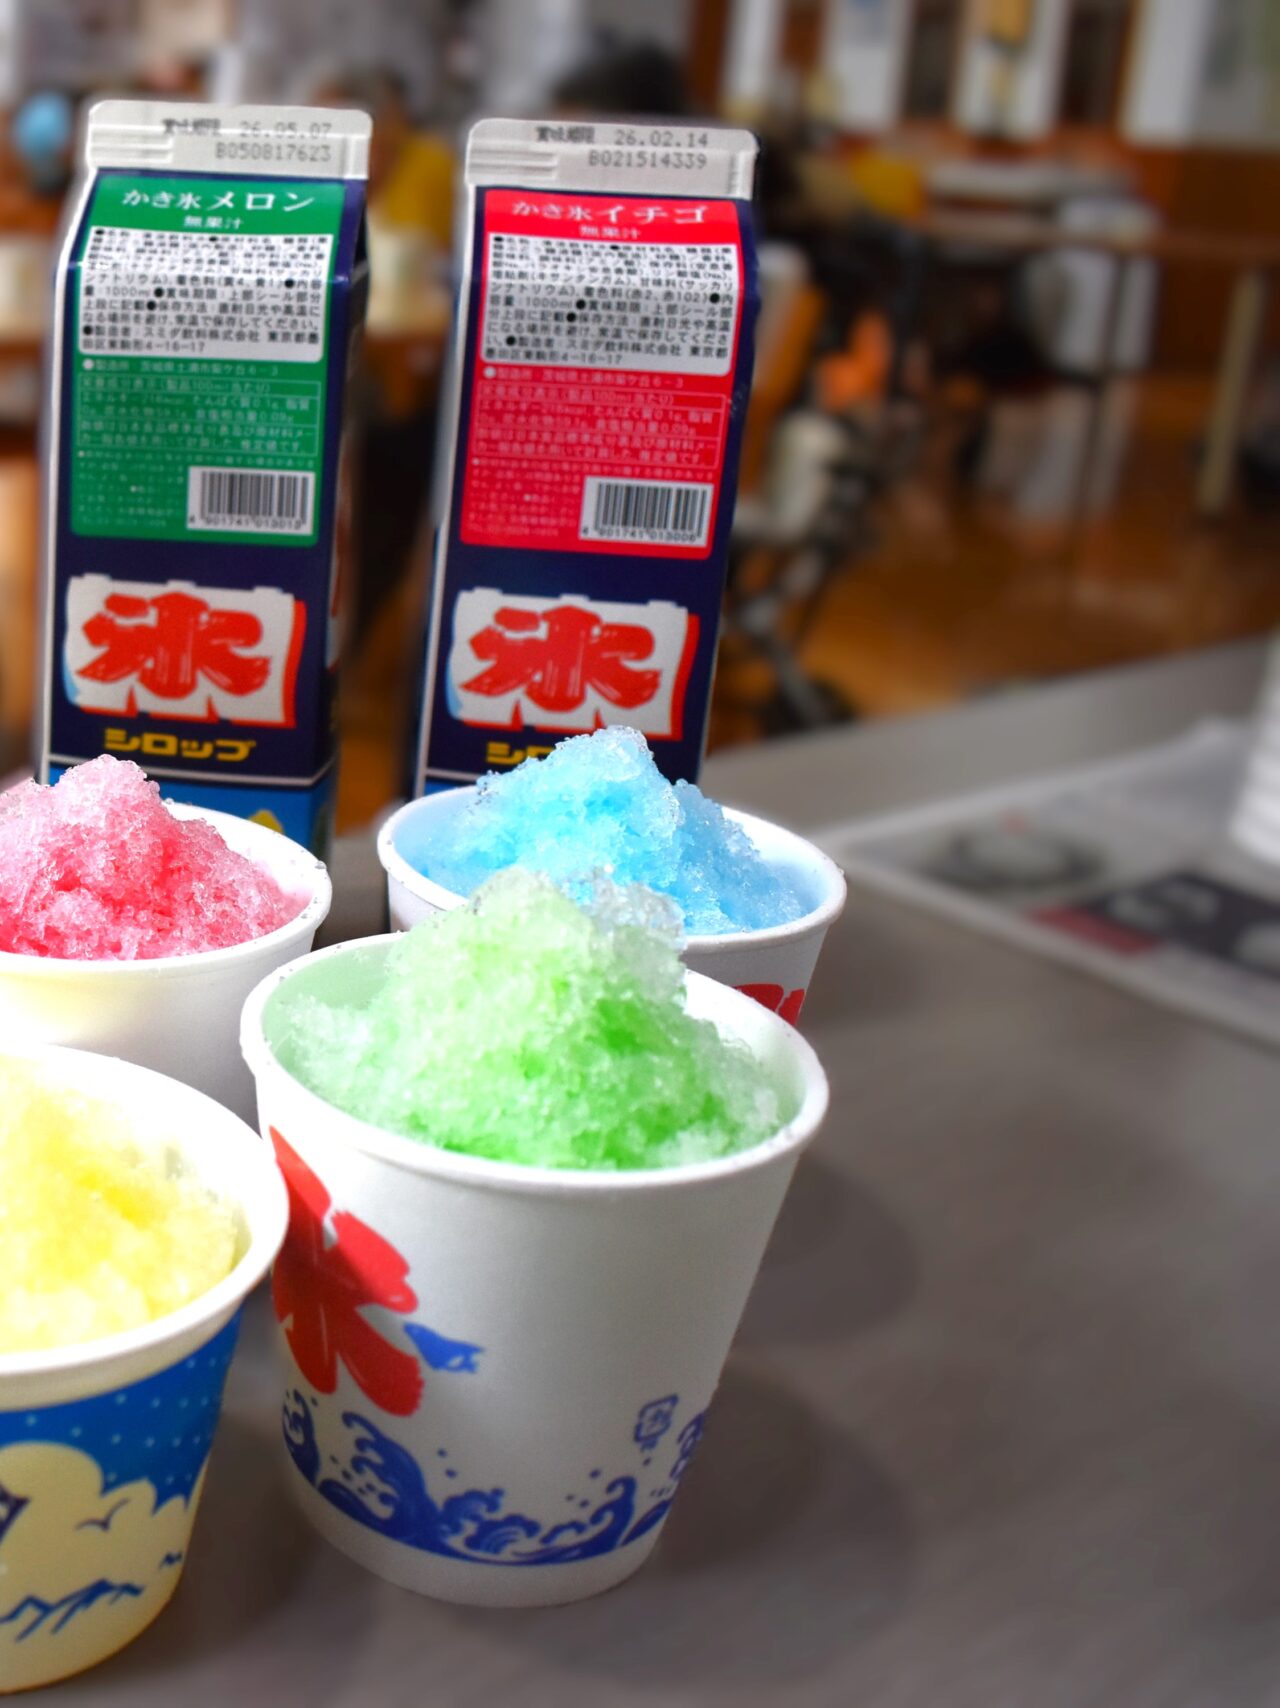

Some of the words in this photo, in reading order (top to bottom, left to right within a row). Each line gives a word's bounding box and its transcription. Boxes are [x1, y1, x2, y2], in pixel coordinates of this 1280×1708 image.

[614, 129, 709, 148] 26.02.14
[588, 150, 708, 169] B021514339
[76, 590, 271, 700] 氷
[459, 605, 661, 713] 氷
[103, 727, 257, 762] シロップ
